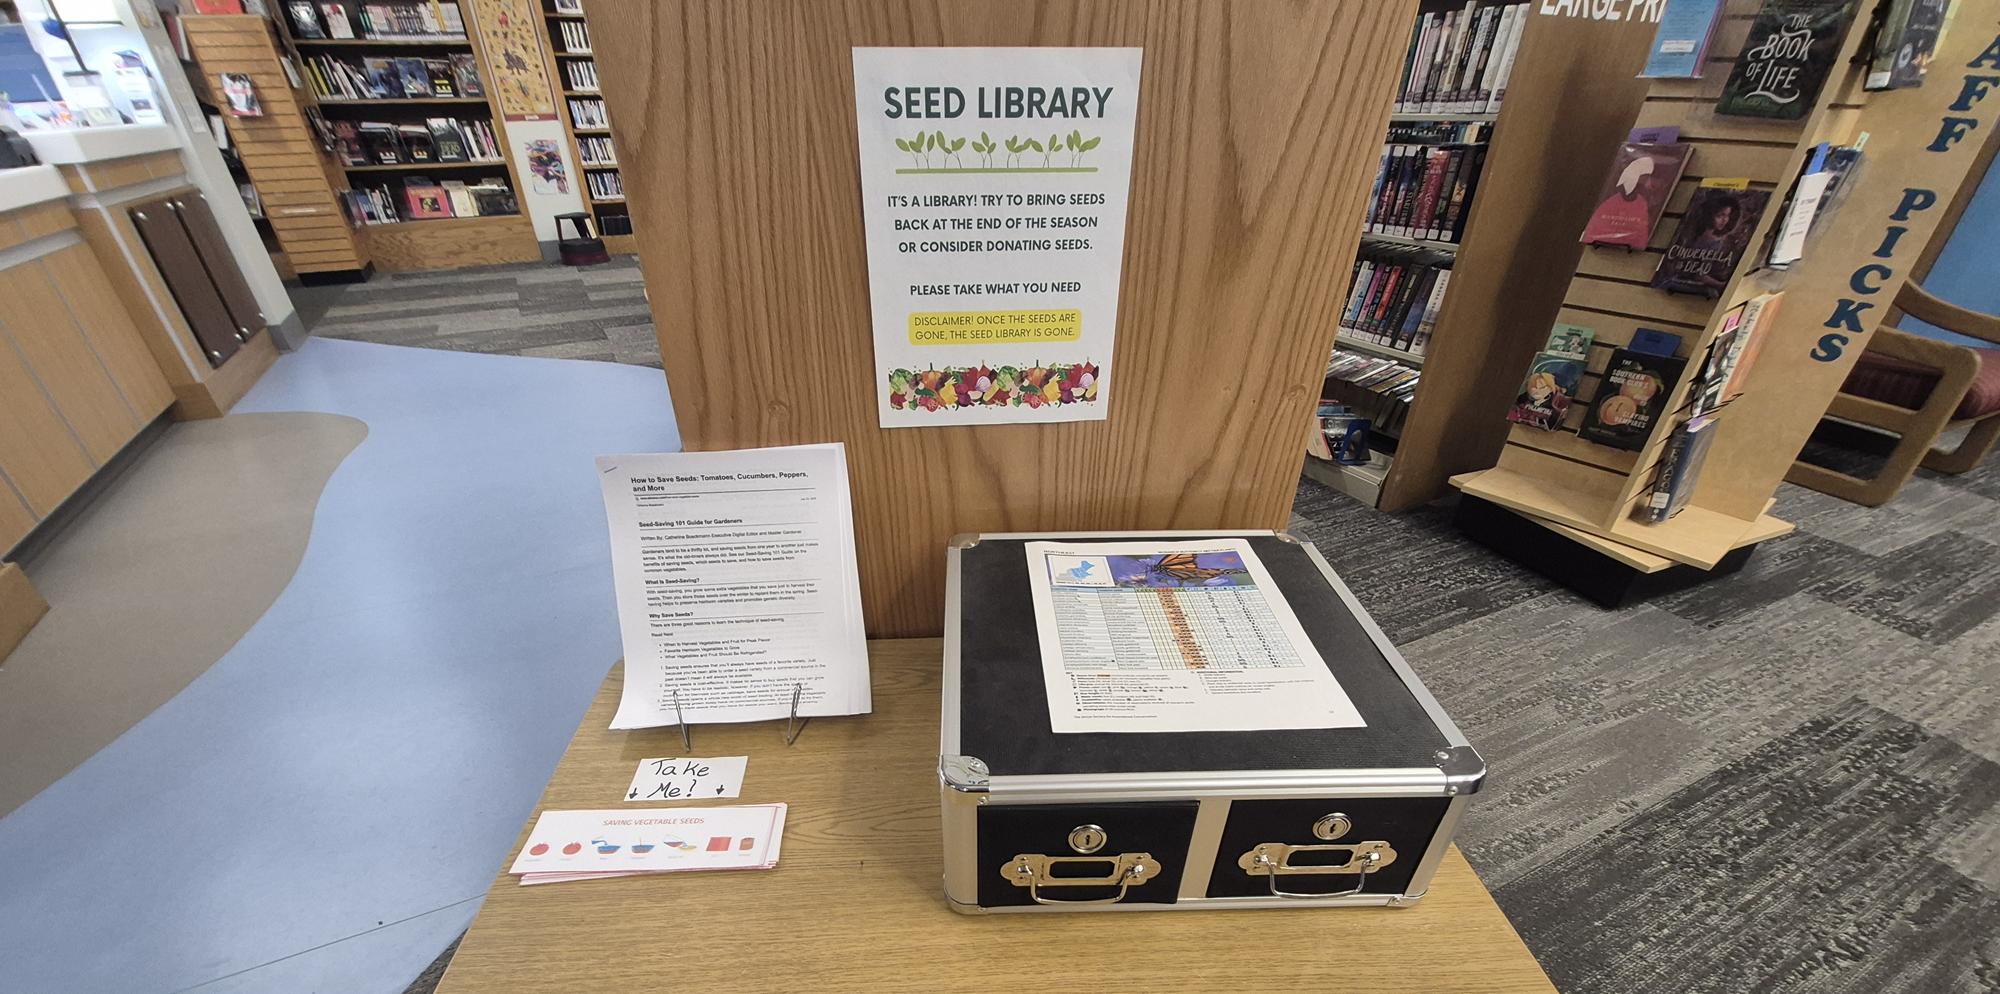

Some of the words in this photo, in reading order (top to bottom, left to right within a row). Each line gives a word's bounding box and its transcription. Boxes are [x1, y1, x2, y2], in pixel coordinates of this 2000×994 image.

[1790, 13, 1813, 30] THE
[1751, 33, 1815, 62] BOOK
[1746, 61, 1762, 80] OF
[1757, 59, 1800, 93] LIFE
[1926, 30, 2000, 152] AFF
[884, 87, 965, 119] SEED
[977, 86, 1114, 119] LIBRARY
[888, 196, 908, 208] IT'S
[911, 196, 920, 208] A
[924, 195, 977, 207] LIBRARY!
[982, 195, 1003, 207] TRY
[1007, 195, 1023, 206] TO
[1027, 194, 1066, 206] BRING
[1070, 194, 1105, 206] SEEDS
[894, 219, 929, 231] BACK
[932, 219, 947, 230] AT
[951, 218, 973, 230] THE
[977, 218, 1002, 230] END
[1005, 218, 1022, 229] OF
[1025, 217, 1047, 229] THE
[1050, 216, 1098, 229] SEASON
[898, 242, 916, 253] OR
[920, 241, 983, 253] CONSIDER
[986, 240, 1051, 252] DONATING
[1055, 239, 1094, 251] SEEDS.
[1668, 244, 1733, 267] CINDERELLA
[1683, 260, 1712, 276] DEAD
[1810, 188, 1936, 362] PICKS
[910, 284, 950, 296] PLEASE
[954, 284, 982, 295] TAKE
[985, 283, 1019, 294] WHAT
[1023, 282, 1048, 293] YOU
[1051, 281, 1081, 293] NEED
[914, 316, 974, 326] DISCLAIMER!
[976, 315, 1005, 325] ONCE
[1009, 314, 1025, 324] THE
[1028, 314, 1056, 324] SEEDS
[1058, 313, 1076, 323] ARE
[915, 330, 948, 342] GONE,
[950, 330, 967, 340] THE
[970, 329, 993, 339] SEED
[996, 328, 1031, 338] LIBRARY
[1034, 328, 1042, 338] IS
[1044, 327, 1075, 337] GONE.
[638, 521, 674, 529] Seed-Saving
[665, 577, 700, 585] Seed-Saving?
[649, 612, 661, 620] Why
[603, 819, 632, 827] SAVING
[634, 818, 677, 826] VEGETABLE
[680, 817, 704, 825] SEEDS
